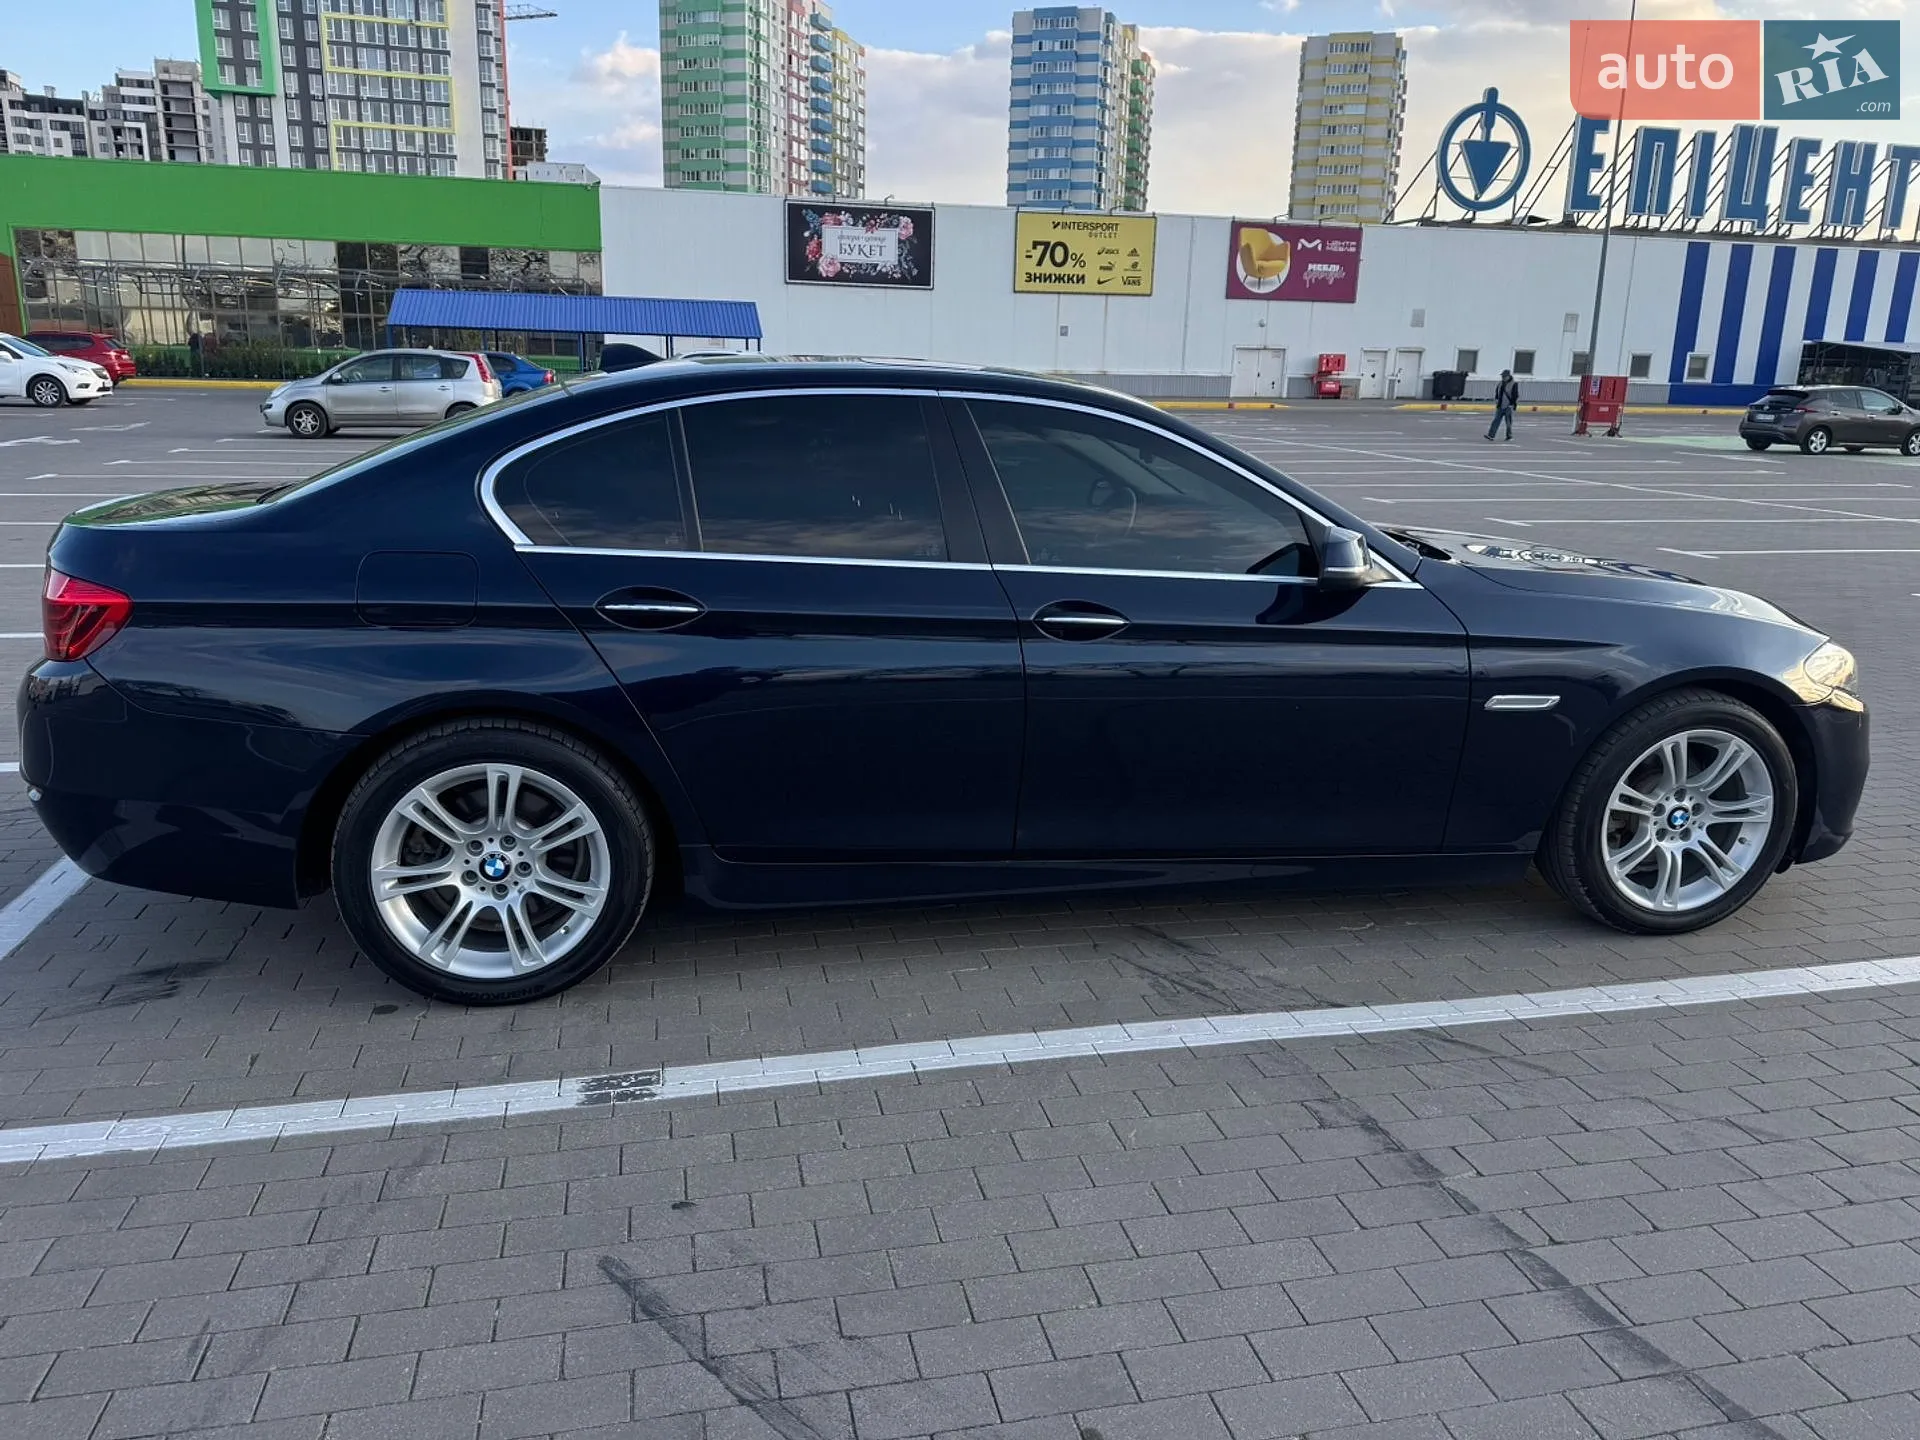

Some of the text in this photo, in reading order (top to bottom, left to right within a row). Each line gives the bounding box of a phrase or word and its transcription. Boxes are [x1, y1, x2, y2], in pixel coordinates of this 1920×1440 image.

[1061, 222, 1119, 232] INTERSPORT
[839, 243, 887, 259] БУКЕТ
[1025, 240, 1087, 268] -70%
[1024, 272, 1086, 285] ЗНИЖКИ
